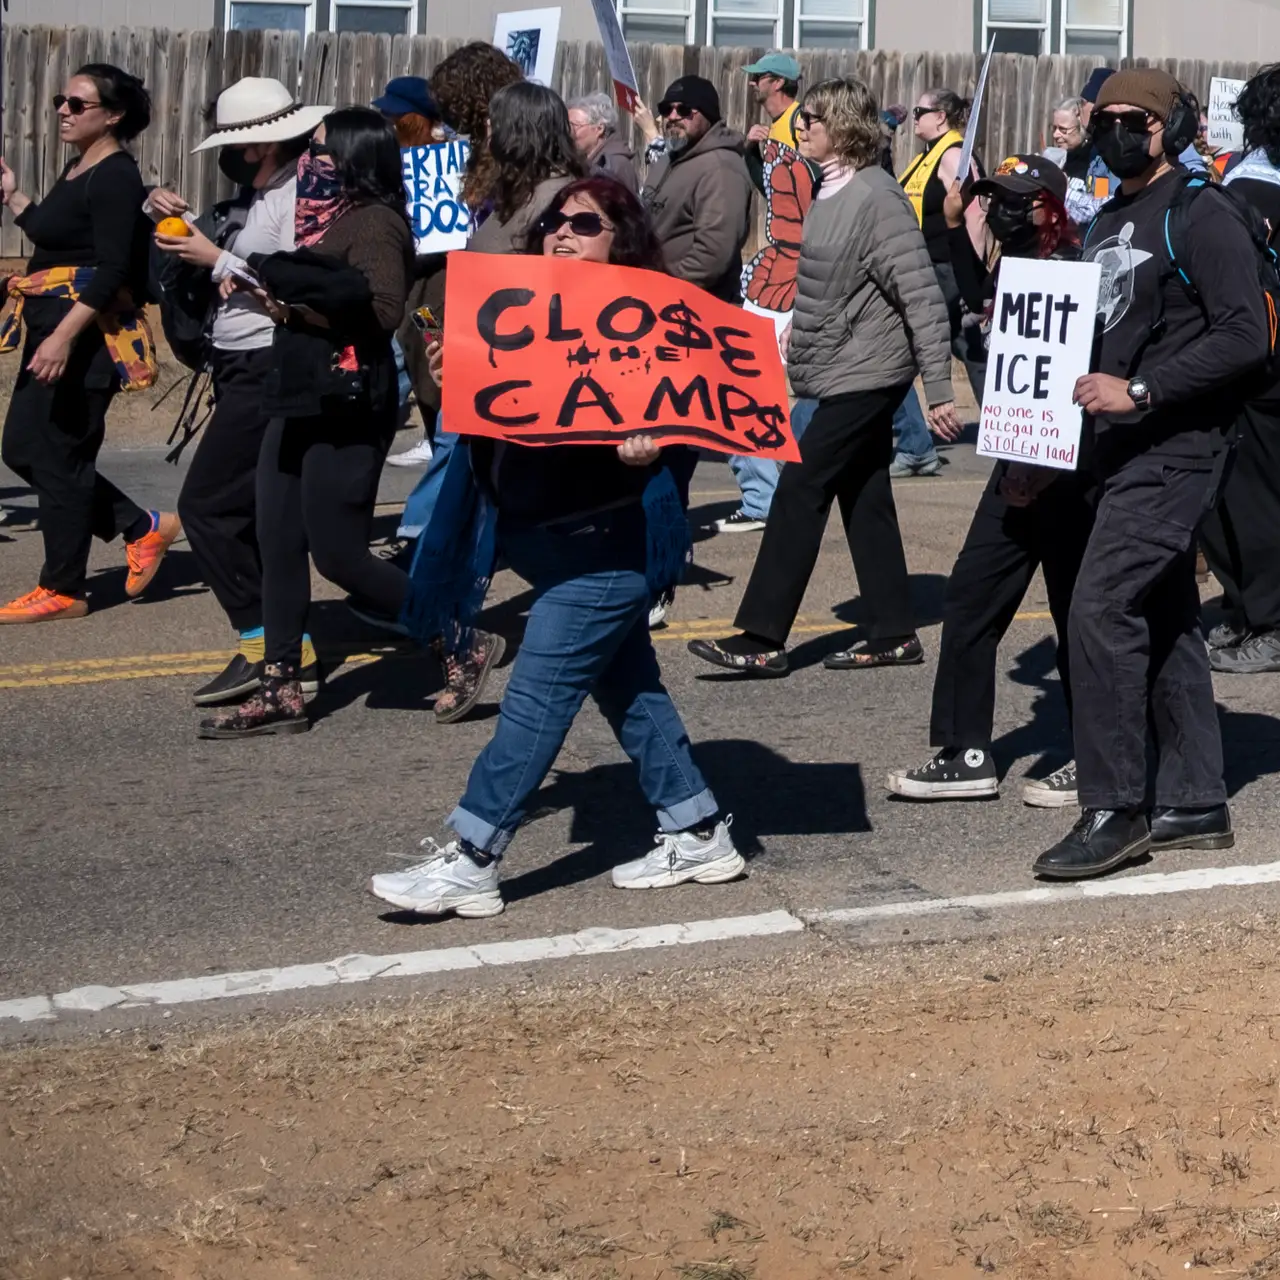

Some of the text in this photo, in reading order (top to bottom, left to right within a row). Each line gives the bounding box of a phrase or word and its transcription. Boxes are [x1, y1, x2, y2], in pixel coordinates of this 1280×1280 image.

[1210, 127, 1232, 140] with
[994, 353, 1052, 400] ICE
[983, 405, 1002, 418] NO
[1007, 407, 1034, 419] one
[1040, 426, 1060, 439] on
[983, 435, 1075, 463] STOLEN land
